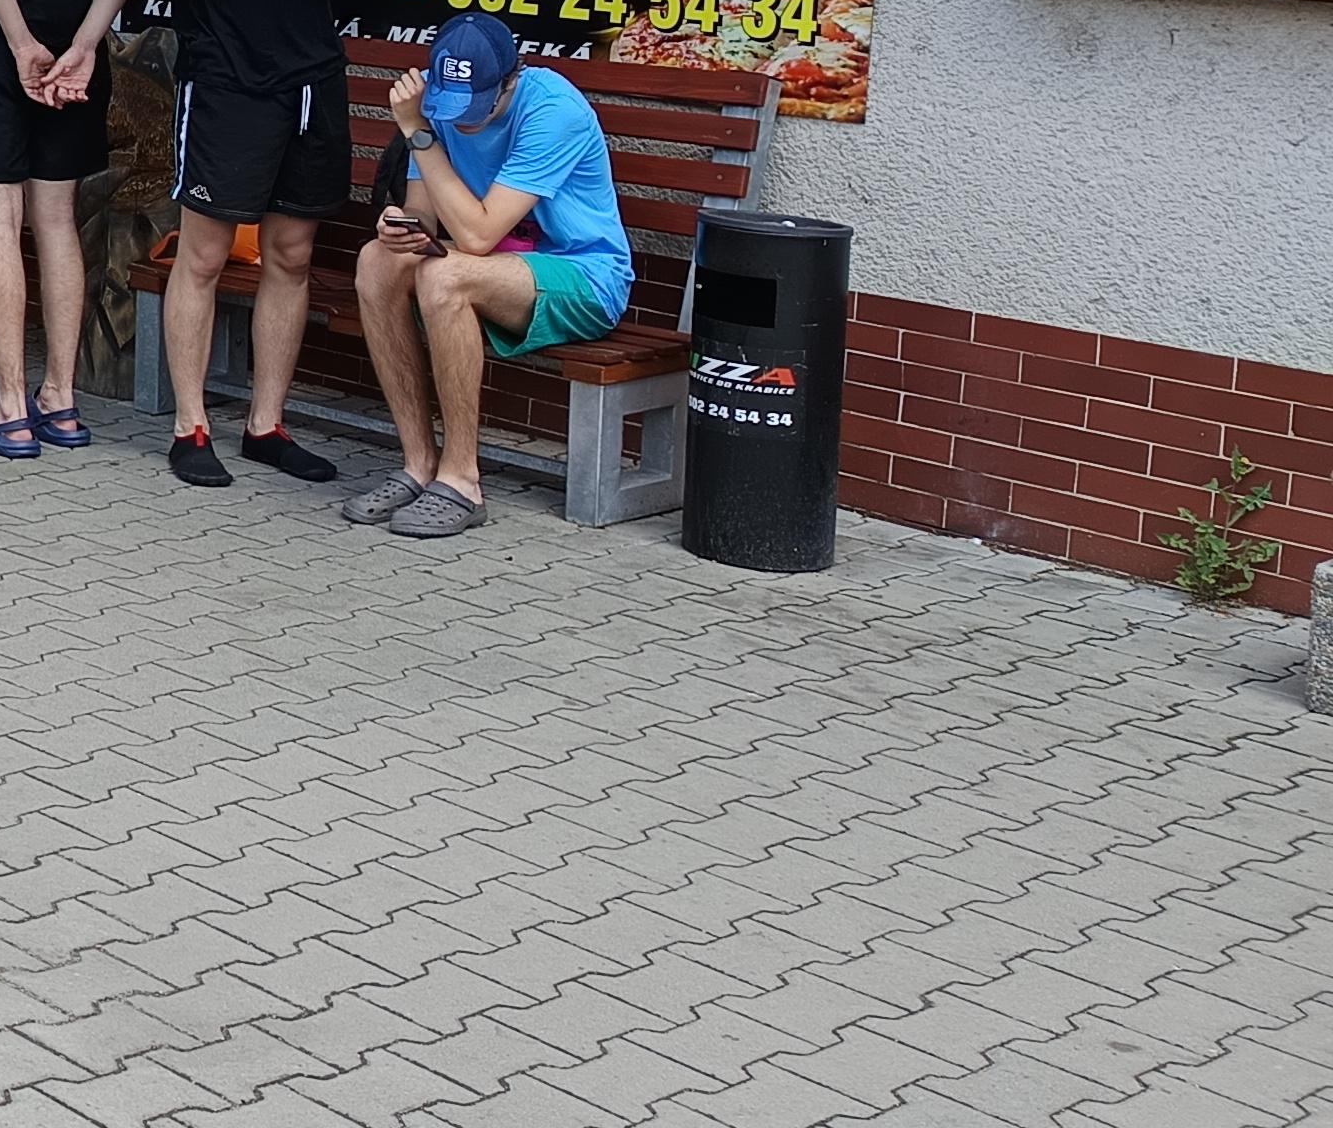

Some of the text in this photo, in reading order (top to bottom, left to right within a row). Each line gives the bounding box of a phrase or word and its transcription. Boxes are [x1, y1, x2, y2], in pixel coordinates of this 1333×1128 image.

[443, 57, 473, 78] ES
[689, 352, 796, 387] IZZA
[735, 383, 796, 396] KRABICE
[708, 403, 730, 420] 24
[734, 408, 761, 425] 54
[765, 412, 793, 427] 34
